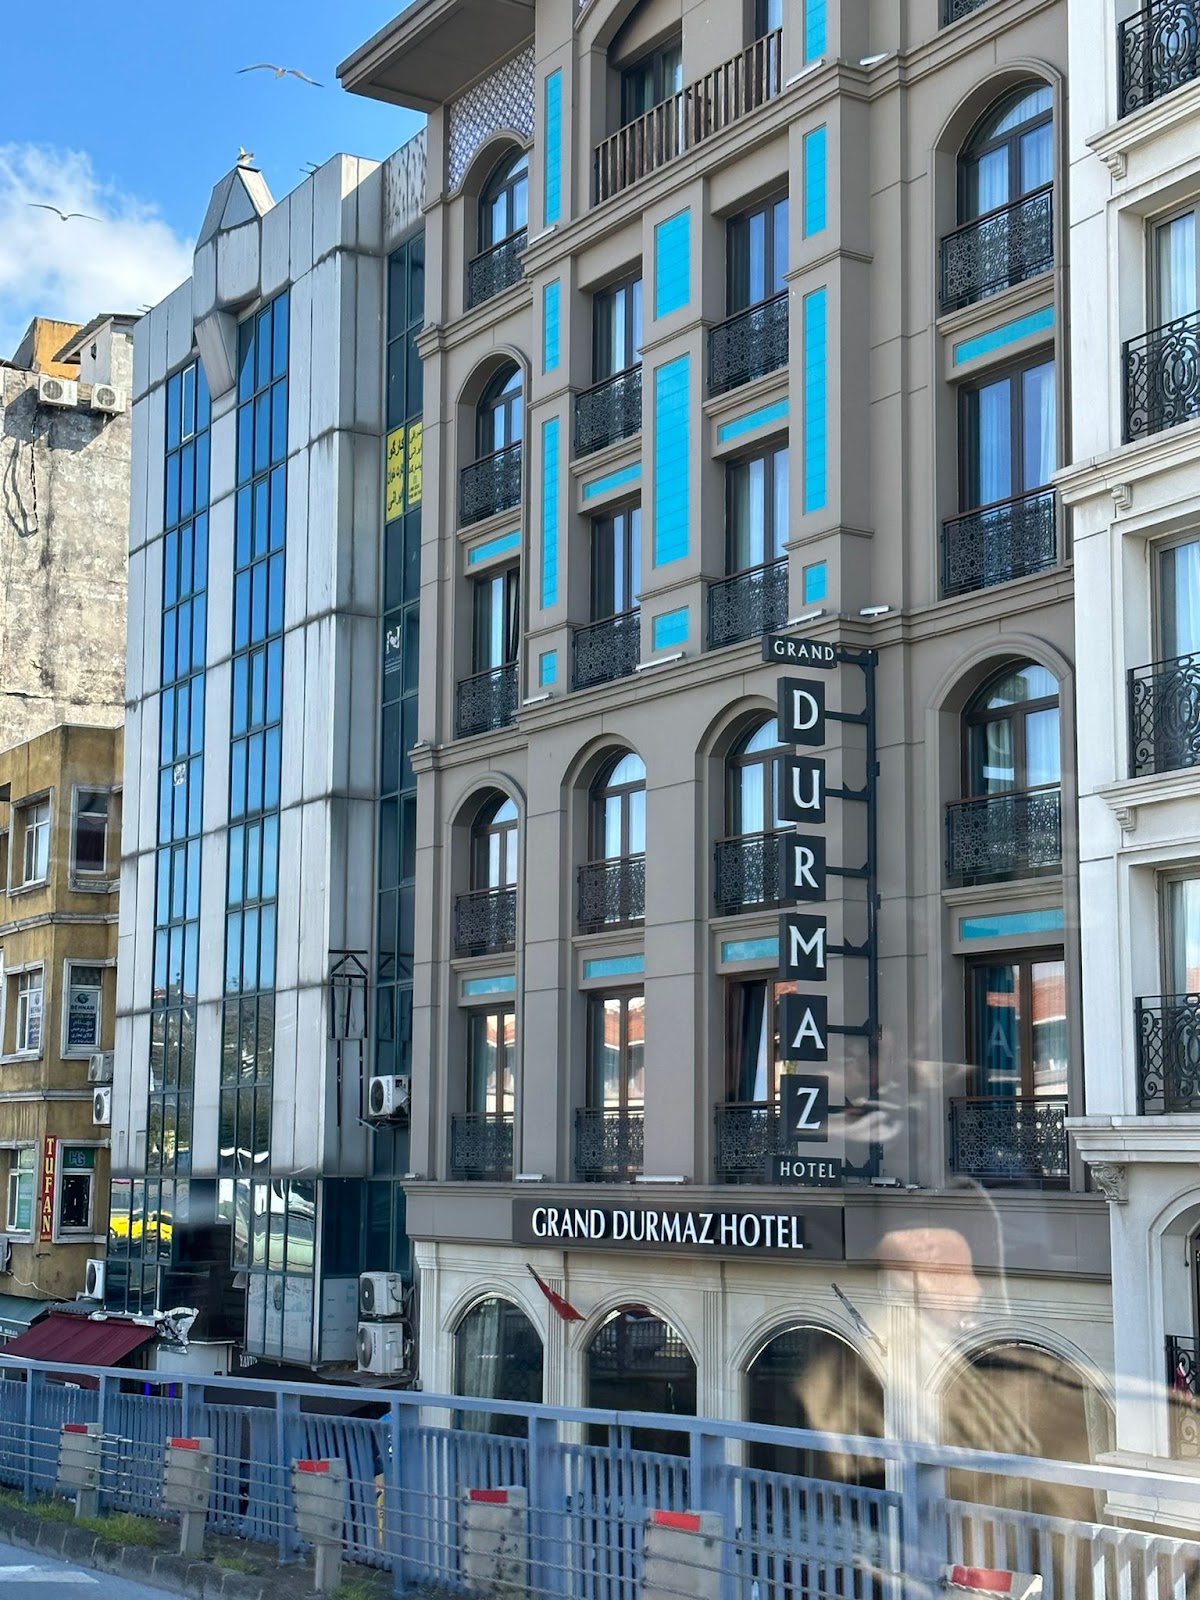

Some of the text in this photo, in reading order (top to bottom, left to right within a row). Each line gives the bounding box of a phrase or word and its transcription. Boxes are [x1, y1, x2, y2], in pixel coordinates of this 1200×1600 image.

[774, 640, 835, 662] GRAND
[789, 689, 826, 1130] DURMAZ
[42, 1138, 54, 1232] TUFAN
[780, 1161, 836, 1179] HOTEL
[532, 1207, 804, 1249] GRAND DURMAZ HOTEL
